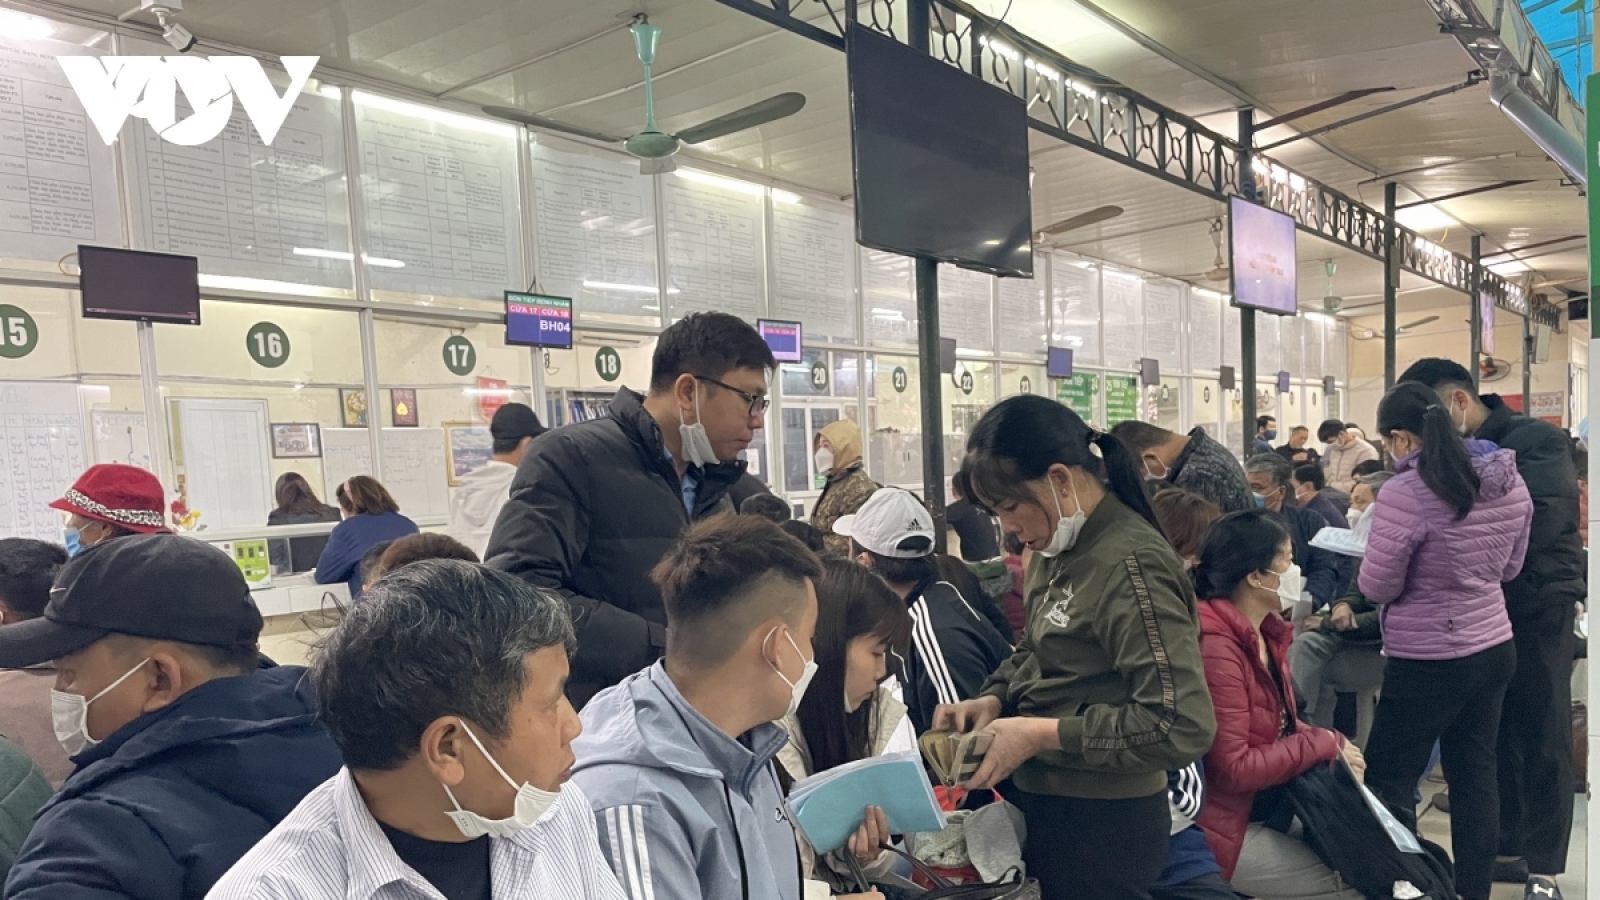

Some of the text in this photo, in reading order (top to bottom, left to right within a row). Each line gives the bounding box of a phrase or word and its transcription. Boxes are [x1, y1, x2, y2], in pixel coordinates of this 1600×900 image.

[540, 320, 571, 332] BH04
[253, 331, 283, 357] 16
[448, 344, 469, 367] 17
[599, 354, 617, 374] 18
[813, 367, 826, 385] 20
[895, 371, 905, 387] 21
[963, 375, 972, 390] 22
